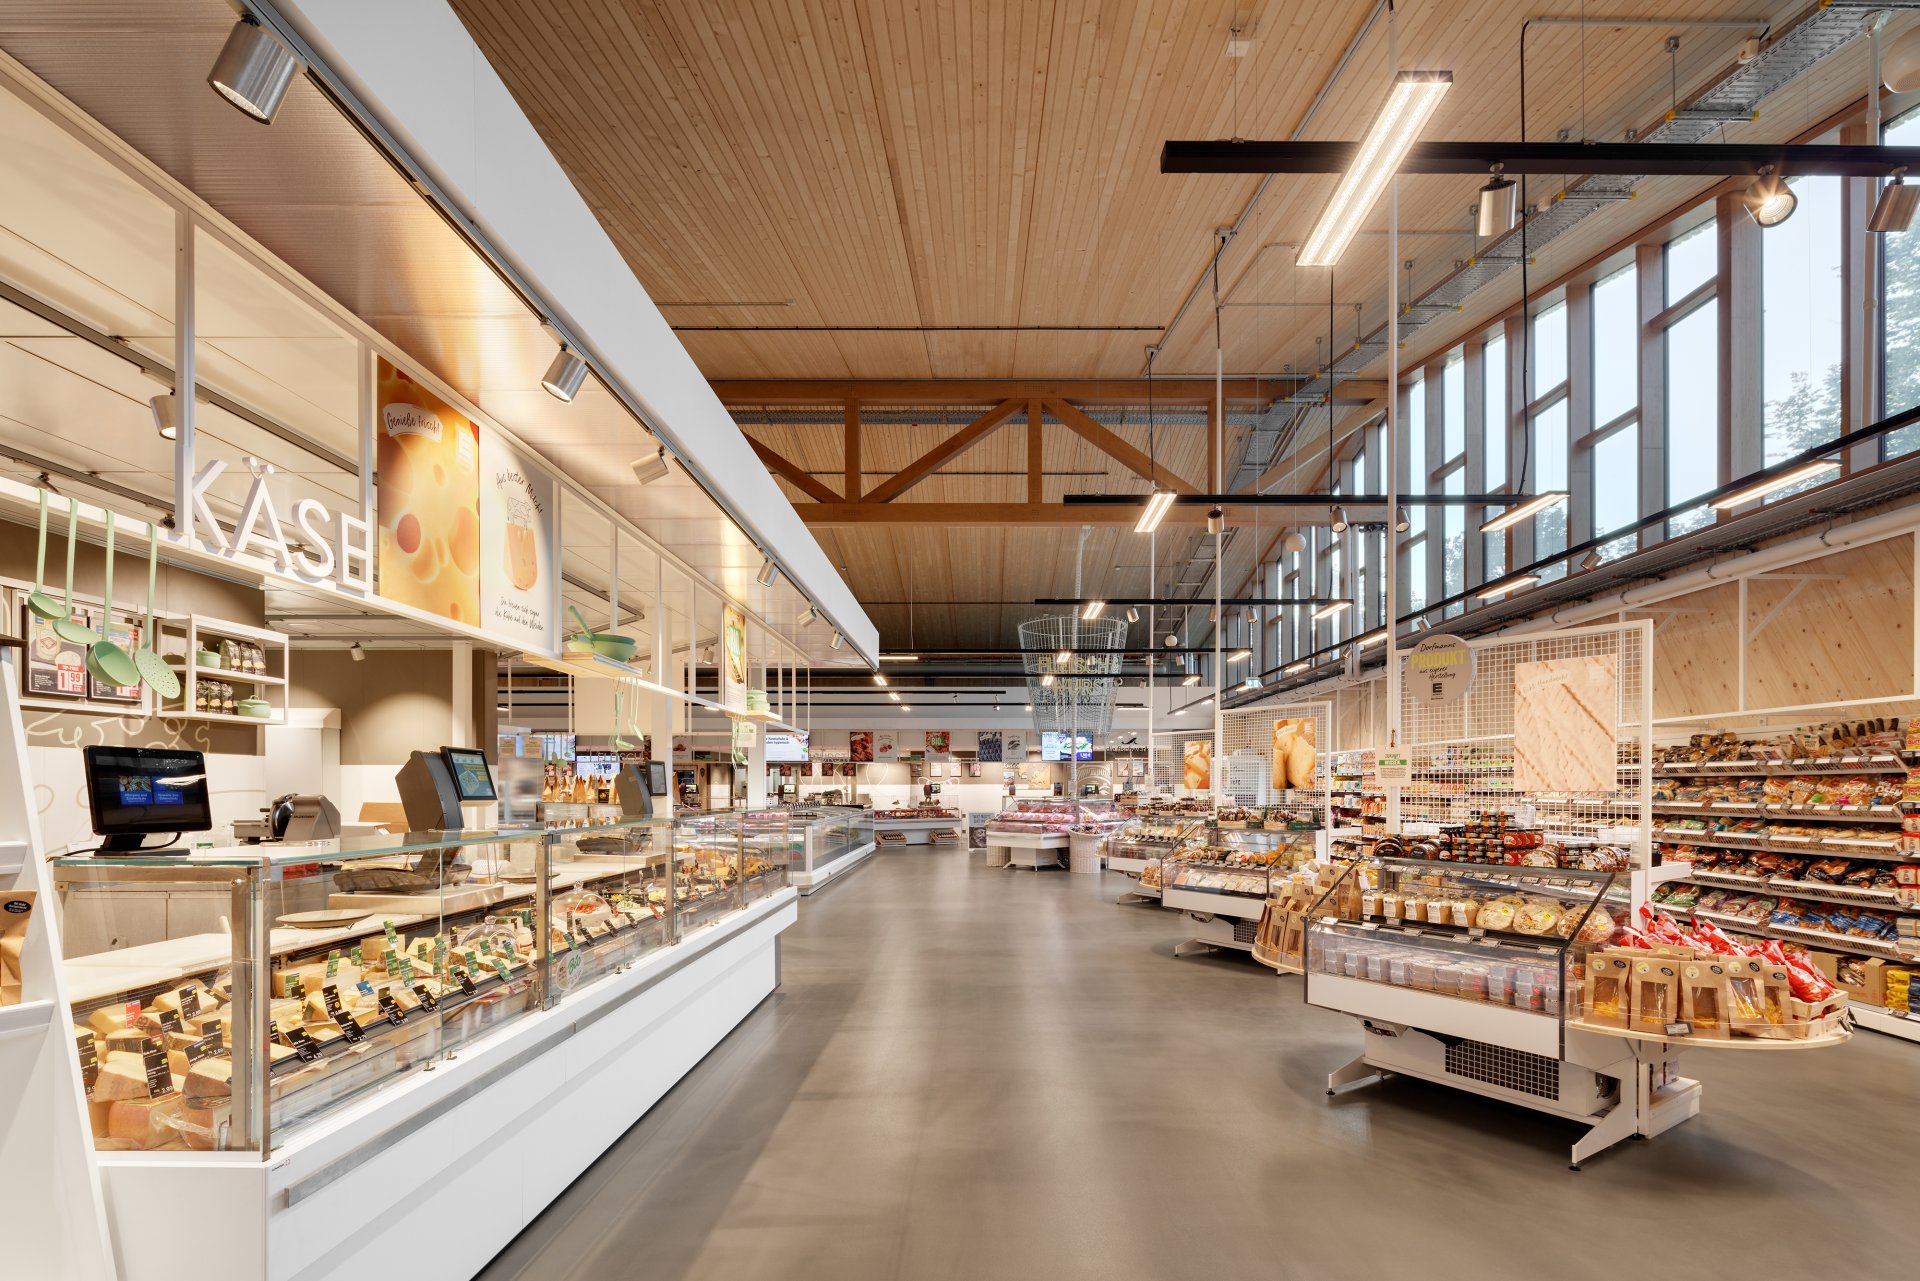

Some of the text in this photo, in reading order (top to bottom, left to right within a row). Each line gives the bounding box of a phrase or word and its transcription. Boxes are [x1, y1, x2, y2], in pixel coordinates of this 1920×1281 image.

[387, 412, 415, 429] Genieße
[176, 456, 373, 593] KÄSE
[1420, 642, 1456, 652] Dorfmanns
[1038, 656, 1109, 674] FLEISCH
[1411, 649, 1465, 670] PRODUKT
